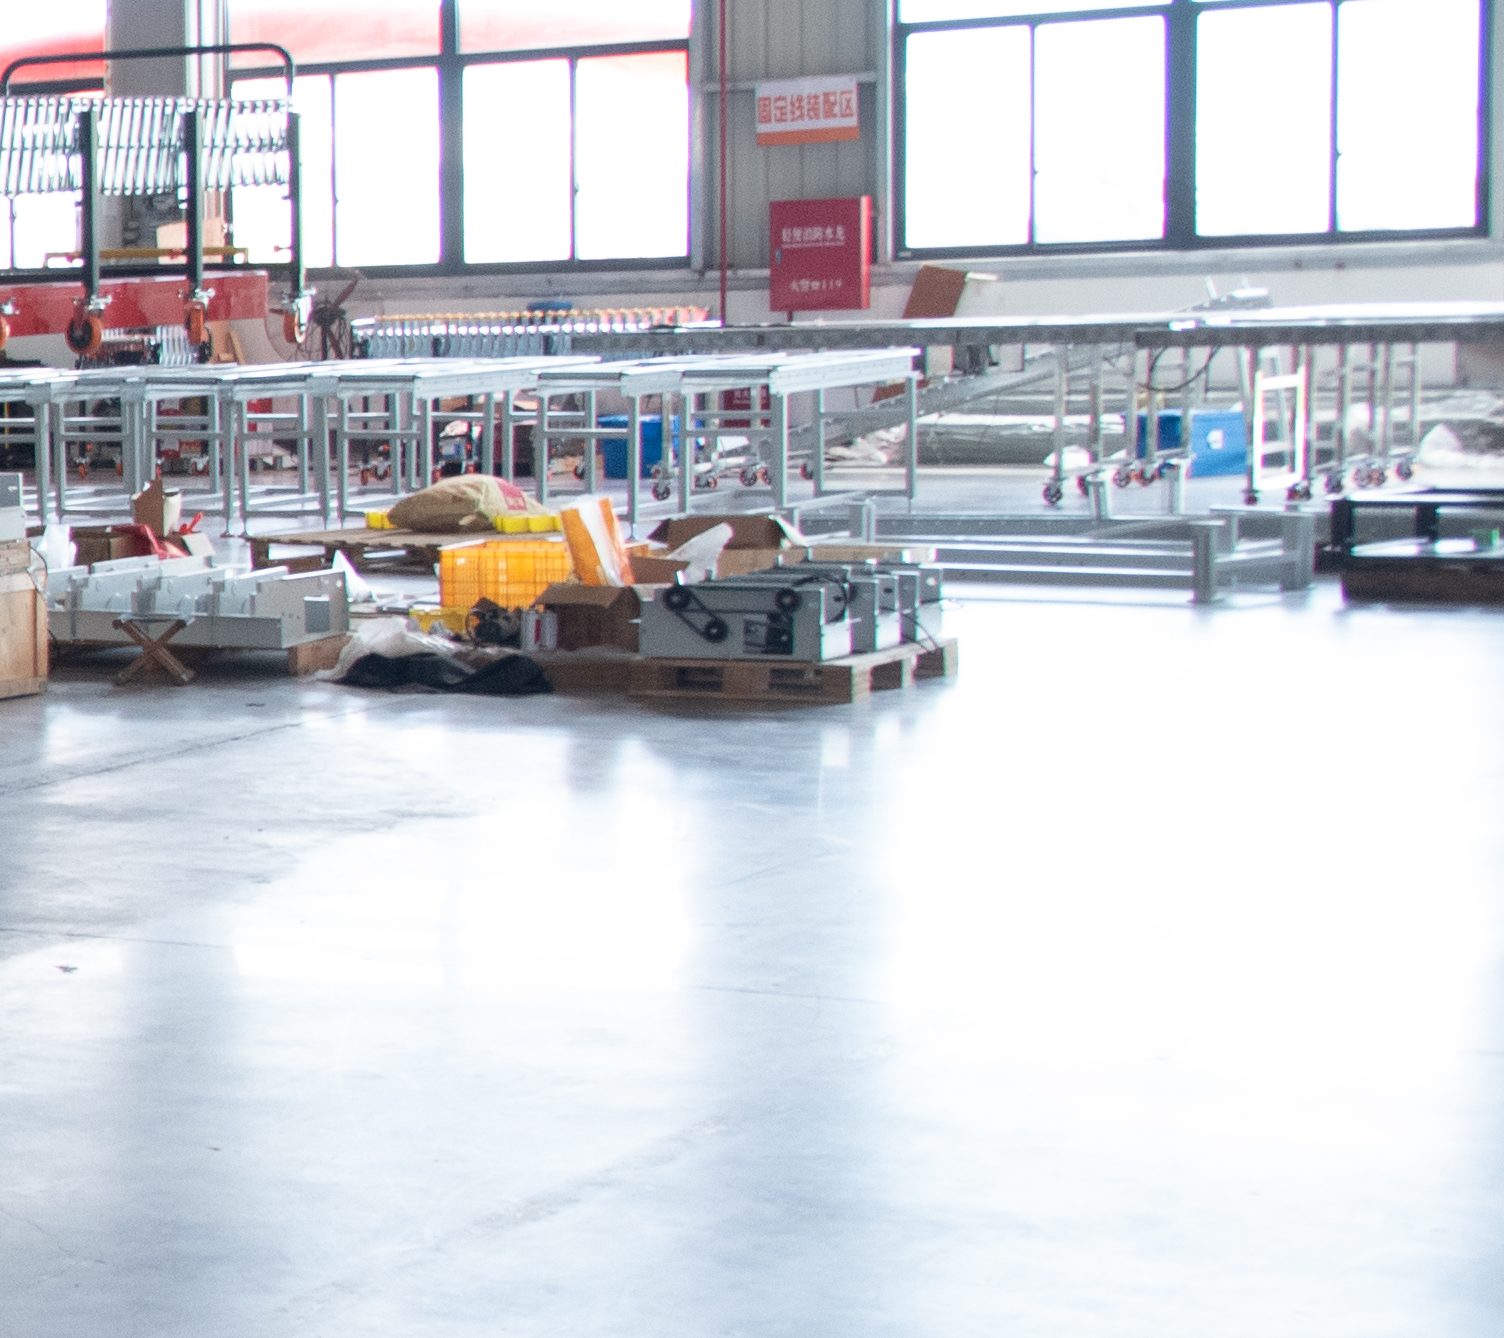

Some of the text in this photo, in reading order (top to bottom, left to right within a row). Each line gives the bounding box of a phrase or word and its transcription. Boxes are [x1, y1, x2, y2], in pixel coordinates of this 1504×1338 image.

[757, 89, 854, 124] 固定线装配区
